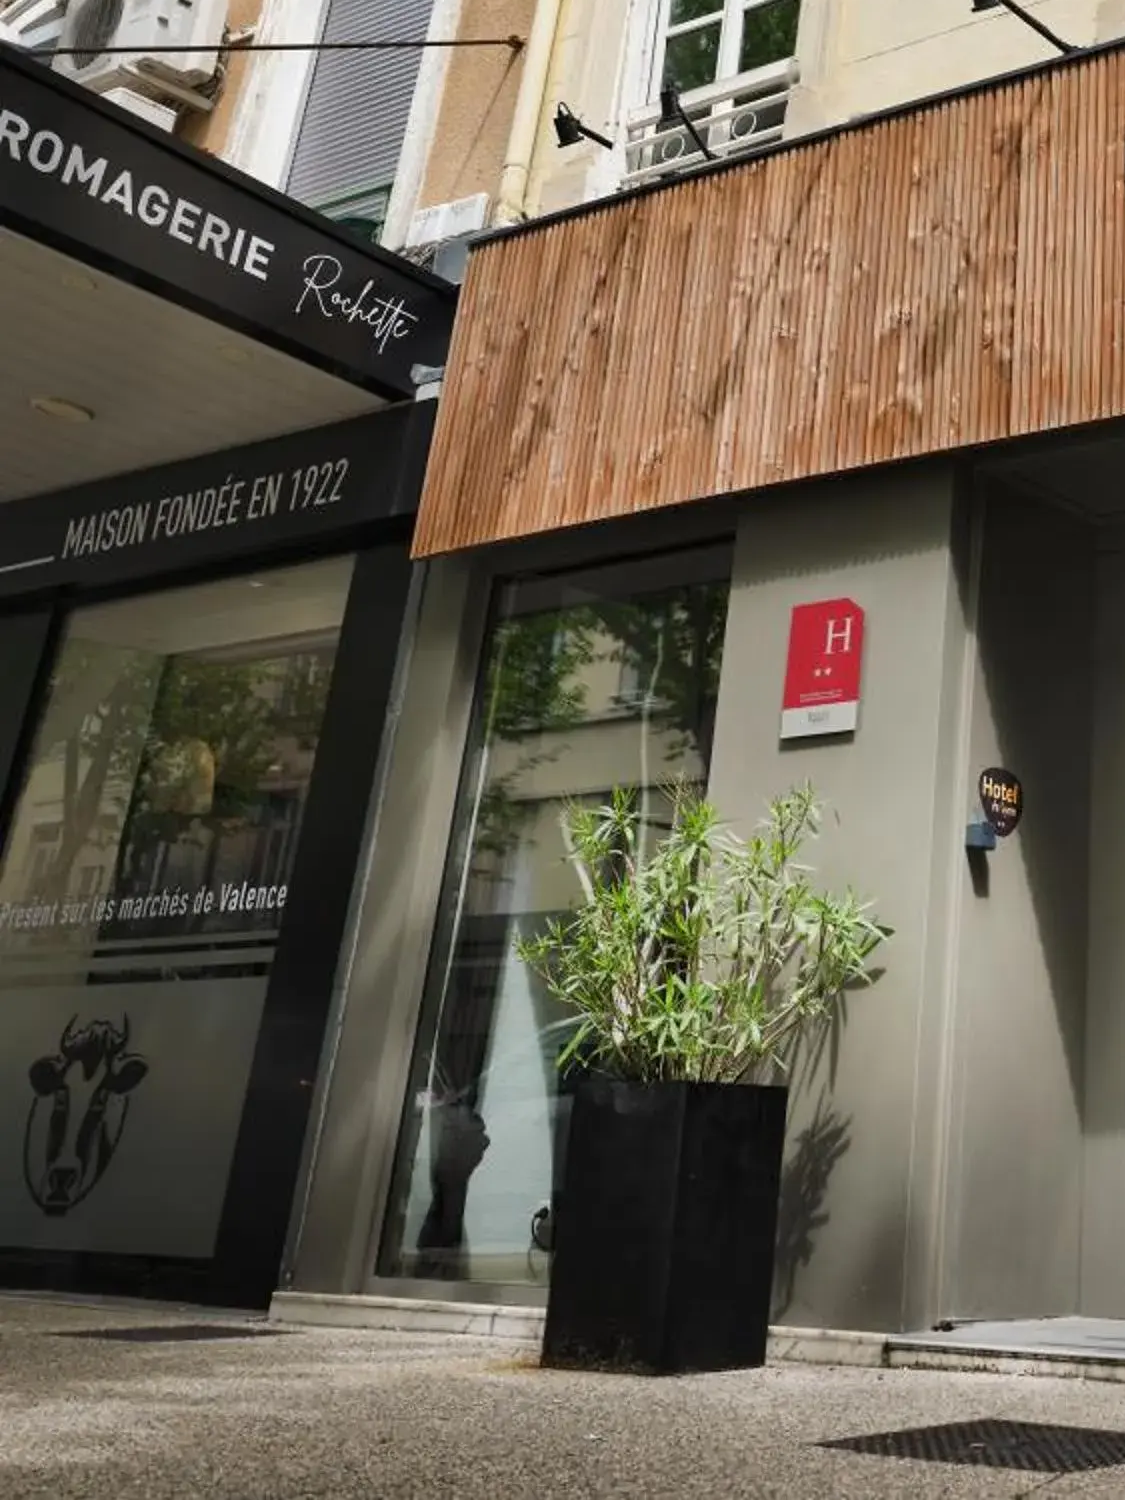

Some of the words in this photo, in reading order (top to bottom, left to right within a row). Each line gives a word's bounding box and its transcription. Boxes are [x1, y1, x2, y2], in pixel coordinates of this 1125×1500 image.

[0, 109, 275, 281] ROMAGERIE
[296, 254, 419, 355] Rochette
[62, 503, 151, 559] MAISON
[152, 474, 246, 540] FONDÉE
[247, 473, 283, 519] EN
[290, 458, 349, 511] 1922
[824, 617, 853, 655] H
[983, 775, 1018, 804] Hotel
[90, 896, 115, 922] les
[118, 887, 189, 920] marchés
[193, 885, 214, 915] de
[219, 881, 287, 912] Valence
